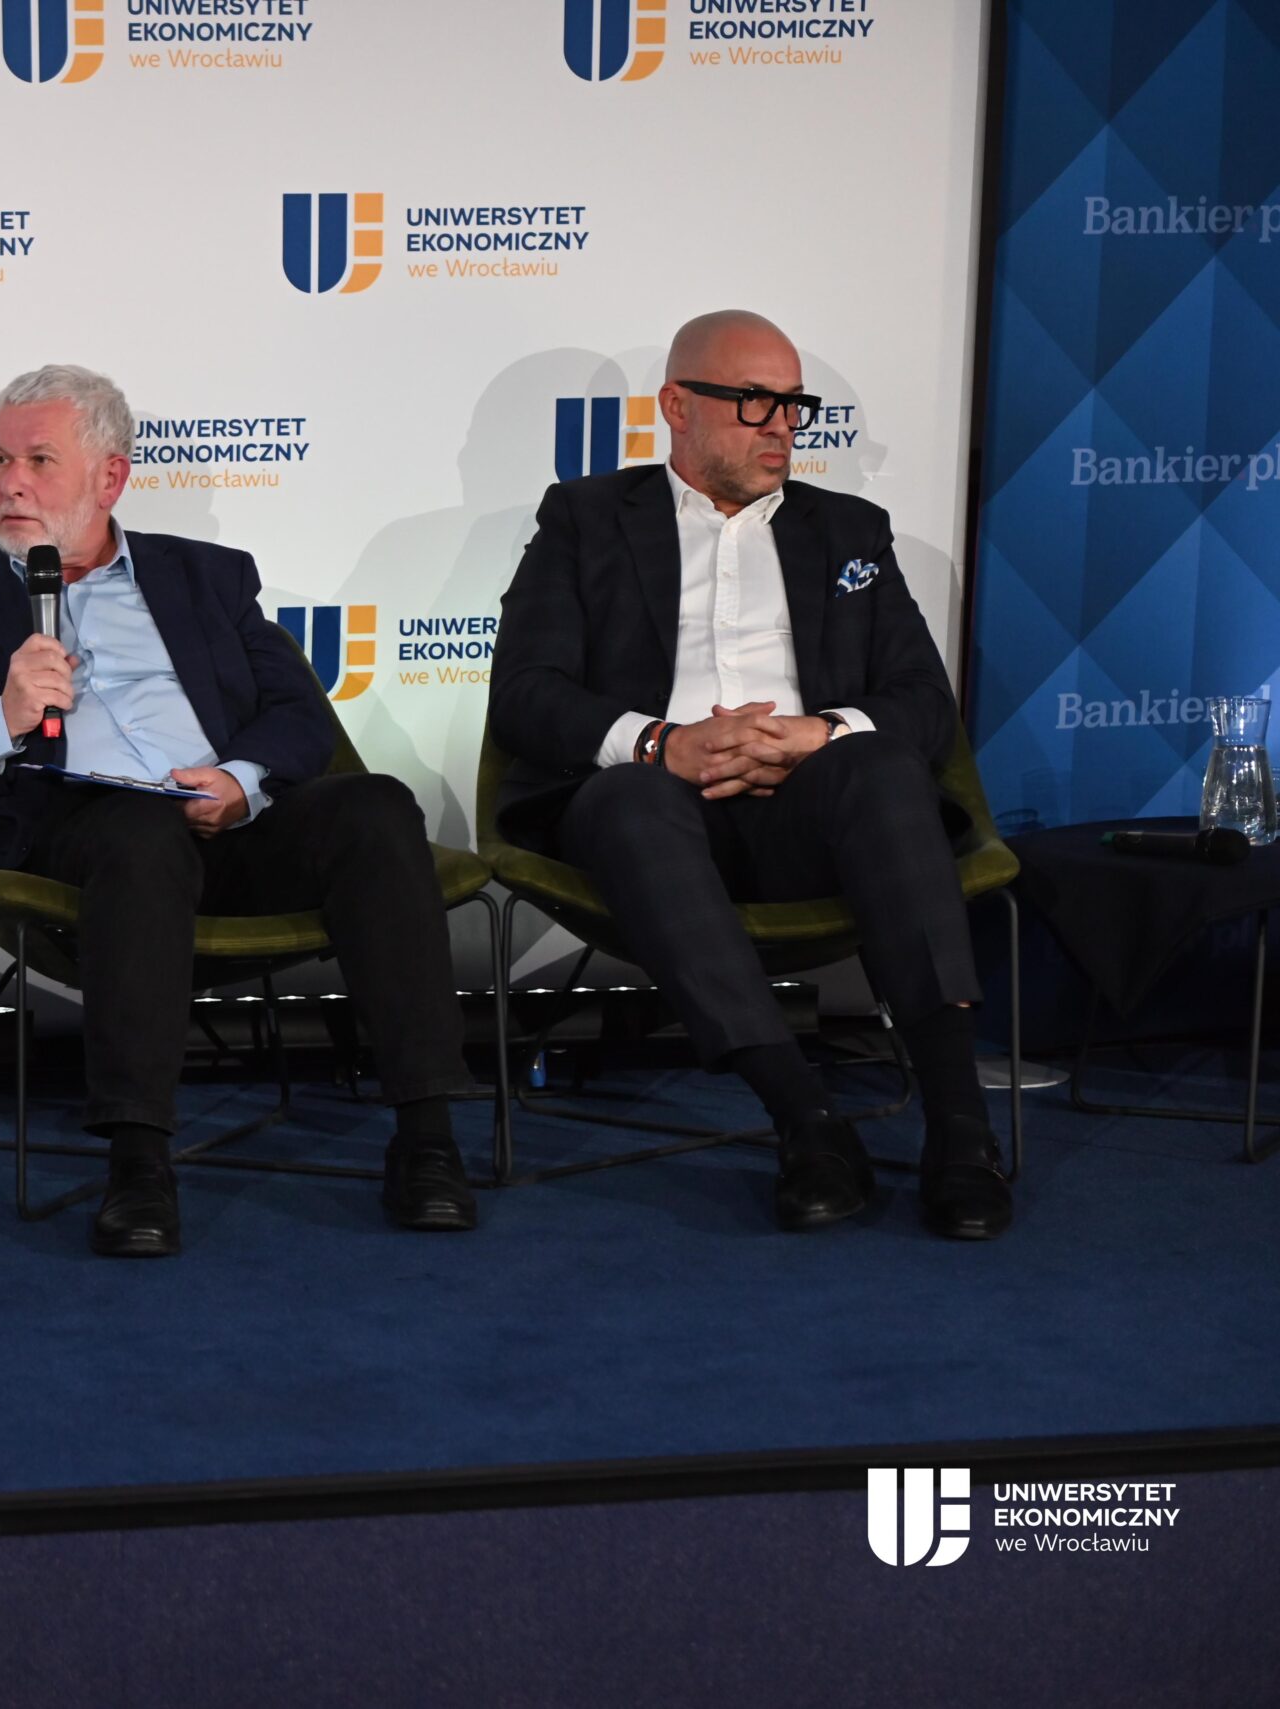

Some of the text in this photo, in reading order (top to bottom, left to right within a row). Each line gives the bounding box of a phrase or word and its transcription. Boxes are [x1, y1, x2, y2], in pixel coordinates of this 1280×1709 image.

[128, 0, 307, 15] UNIWERSYTET
[691, 0, 865, 14] UNIWERSYTET
[129, 22, 312, 41] EKONOMICZNY
[690, 19, 874, 39] EKONOMICZNY
[129, 48, 283, 69] we Wrocławiu
[690, 47, 842, 65] we Wrocławiu
[407, 207, 585, 226] UNIWERSYTET
[407, 232, 588, 251] EKONOMICZNY
[408, 257, 560, 278] we Wrocławiu
[129, 470, 280, 491] we Wrocławiu
[399, 617, 498, 636] UNIWER
[400, 672, 430, 685] we
